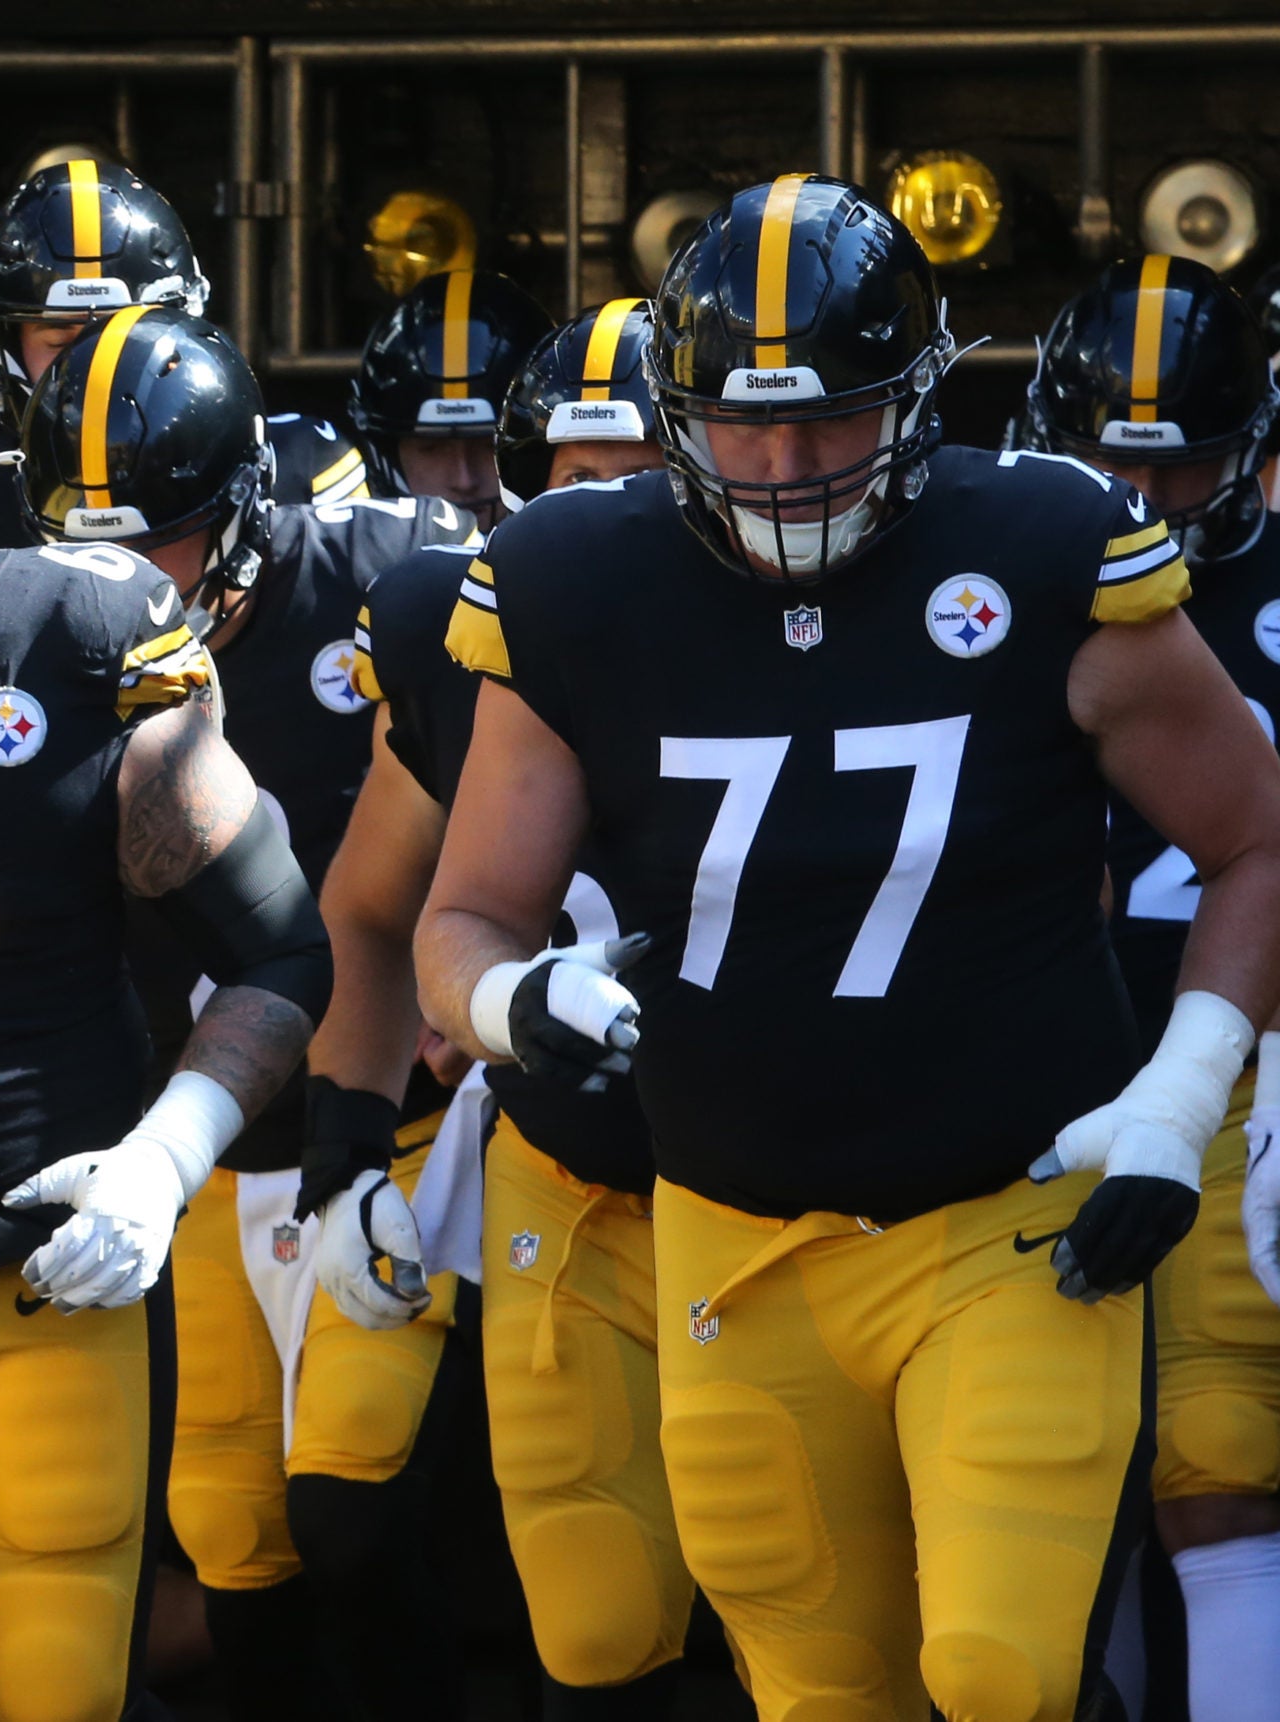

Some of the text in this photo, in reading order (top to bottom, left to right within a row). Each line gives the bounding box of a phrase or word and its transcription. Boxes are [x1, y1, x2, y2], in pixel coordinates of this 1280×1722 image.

[67, 283, 110, 297] Steelers
[746, 373, 798, 389] Steelers
[436, 401, 475, 415] Steelers
[570, 406, 616, 421] Steelers
[1121, 425, 1164, 439] Steelers
[80, 514, 123, 528] Steelers
[933, 610, 966, 622] Steelers
[792, 624, 816, 641] NFL
[660, 713, 972, 998] 77
[275, 1241, 298, 1259] NFL
[512, 1247, 532, 1262] NFL
[694, 1318, 715, 1336] NFL
